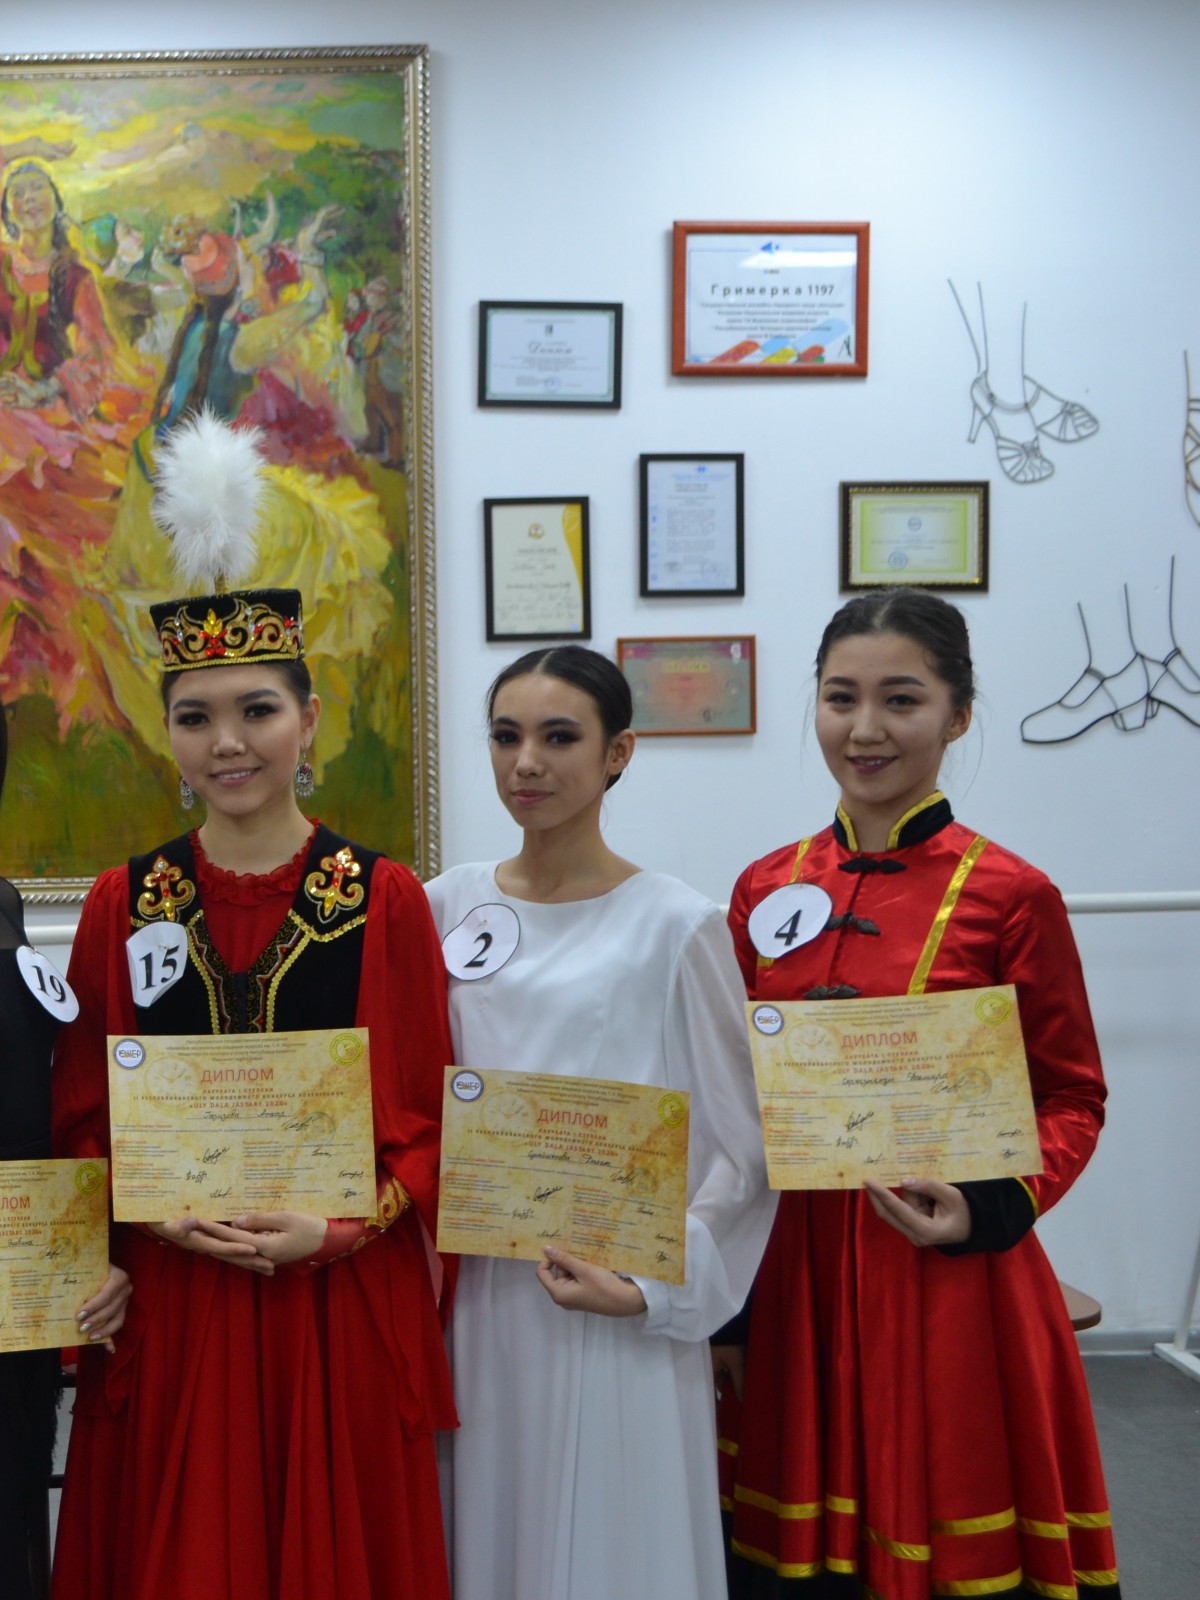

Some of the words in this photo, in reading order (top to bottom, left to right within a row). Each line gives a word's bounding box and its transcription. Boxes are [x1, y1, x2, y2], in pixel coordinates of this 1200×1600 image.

[711, 284, 803, 298] Гримерка
[808, 284, 835, 296] 1197
[775, 909, 800, 946] 4
[463, 932, 493, 968] 2
[138, 945, 181, 990] 15
[31, 961, 67, 1003] 19
[841, 1031, 918, 1050] ДИПЛОМ
[200, 1068, 274, 1084] ДИПЛОМ
[537, 1108, 608, 1129] ДИПЛОМ
